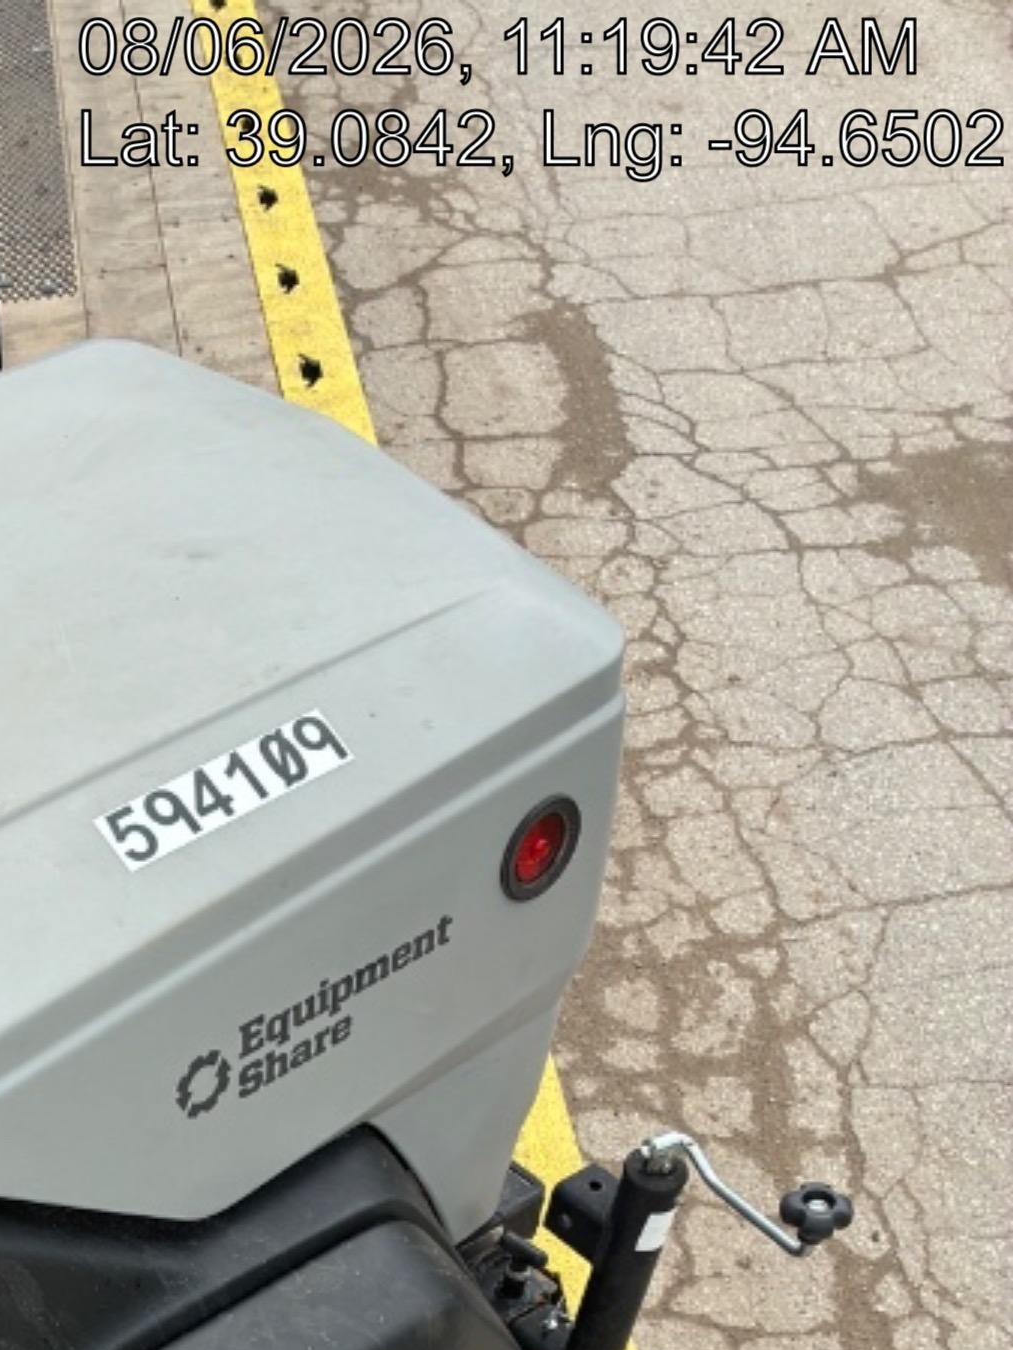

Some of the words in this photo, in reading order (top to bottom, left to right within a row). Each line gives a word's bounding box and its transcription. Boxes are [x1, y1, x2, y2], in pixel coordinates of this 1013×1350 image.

[105, 715, 349, 862] 594109
[238, 914, 453, 1060] Equipment
[238, 1013, 353, 1099] Share
